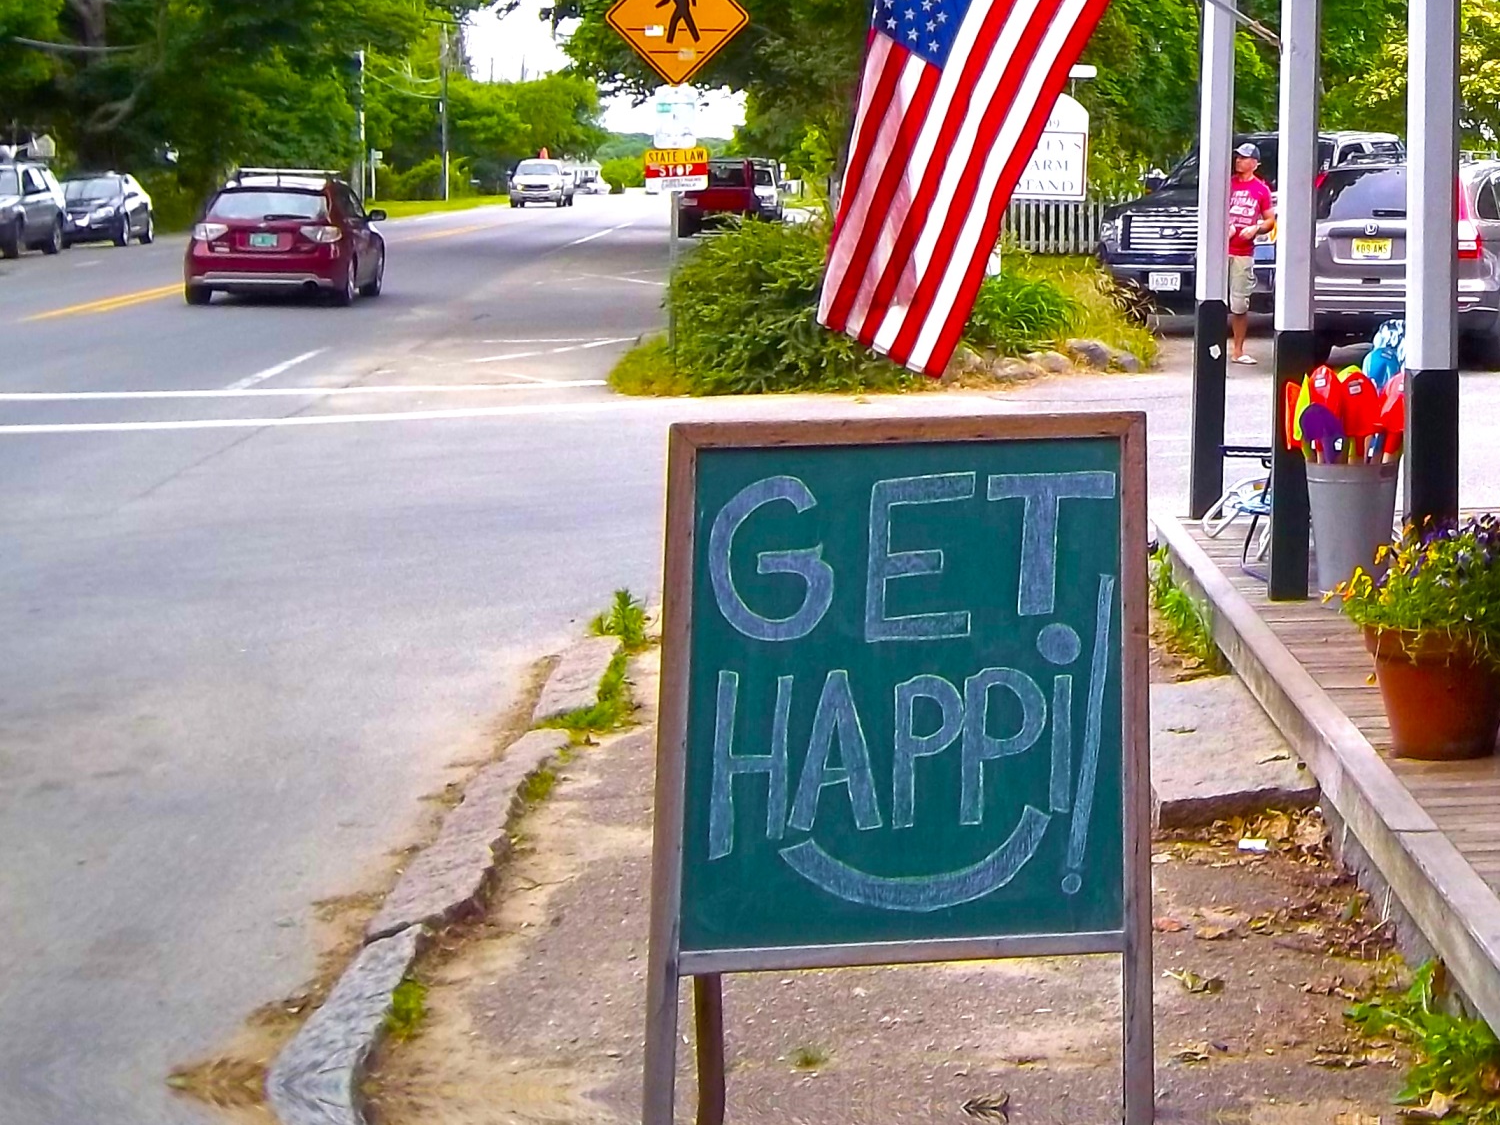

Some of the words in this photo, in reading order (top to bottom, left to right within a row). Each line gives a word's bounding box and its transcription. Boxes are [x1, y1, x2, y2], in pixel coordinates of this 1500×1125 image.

[648, 150, 678, 163] STATE
[683, 150, 705, 162] LAW
[659, 164, 694, 177] STOP
[1029, 158, 1069, 172] ARM
[708, 472, 1116, 642] GET
